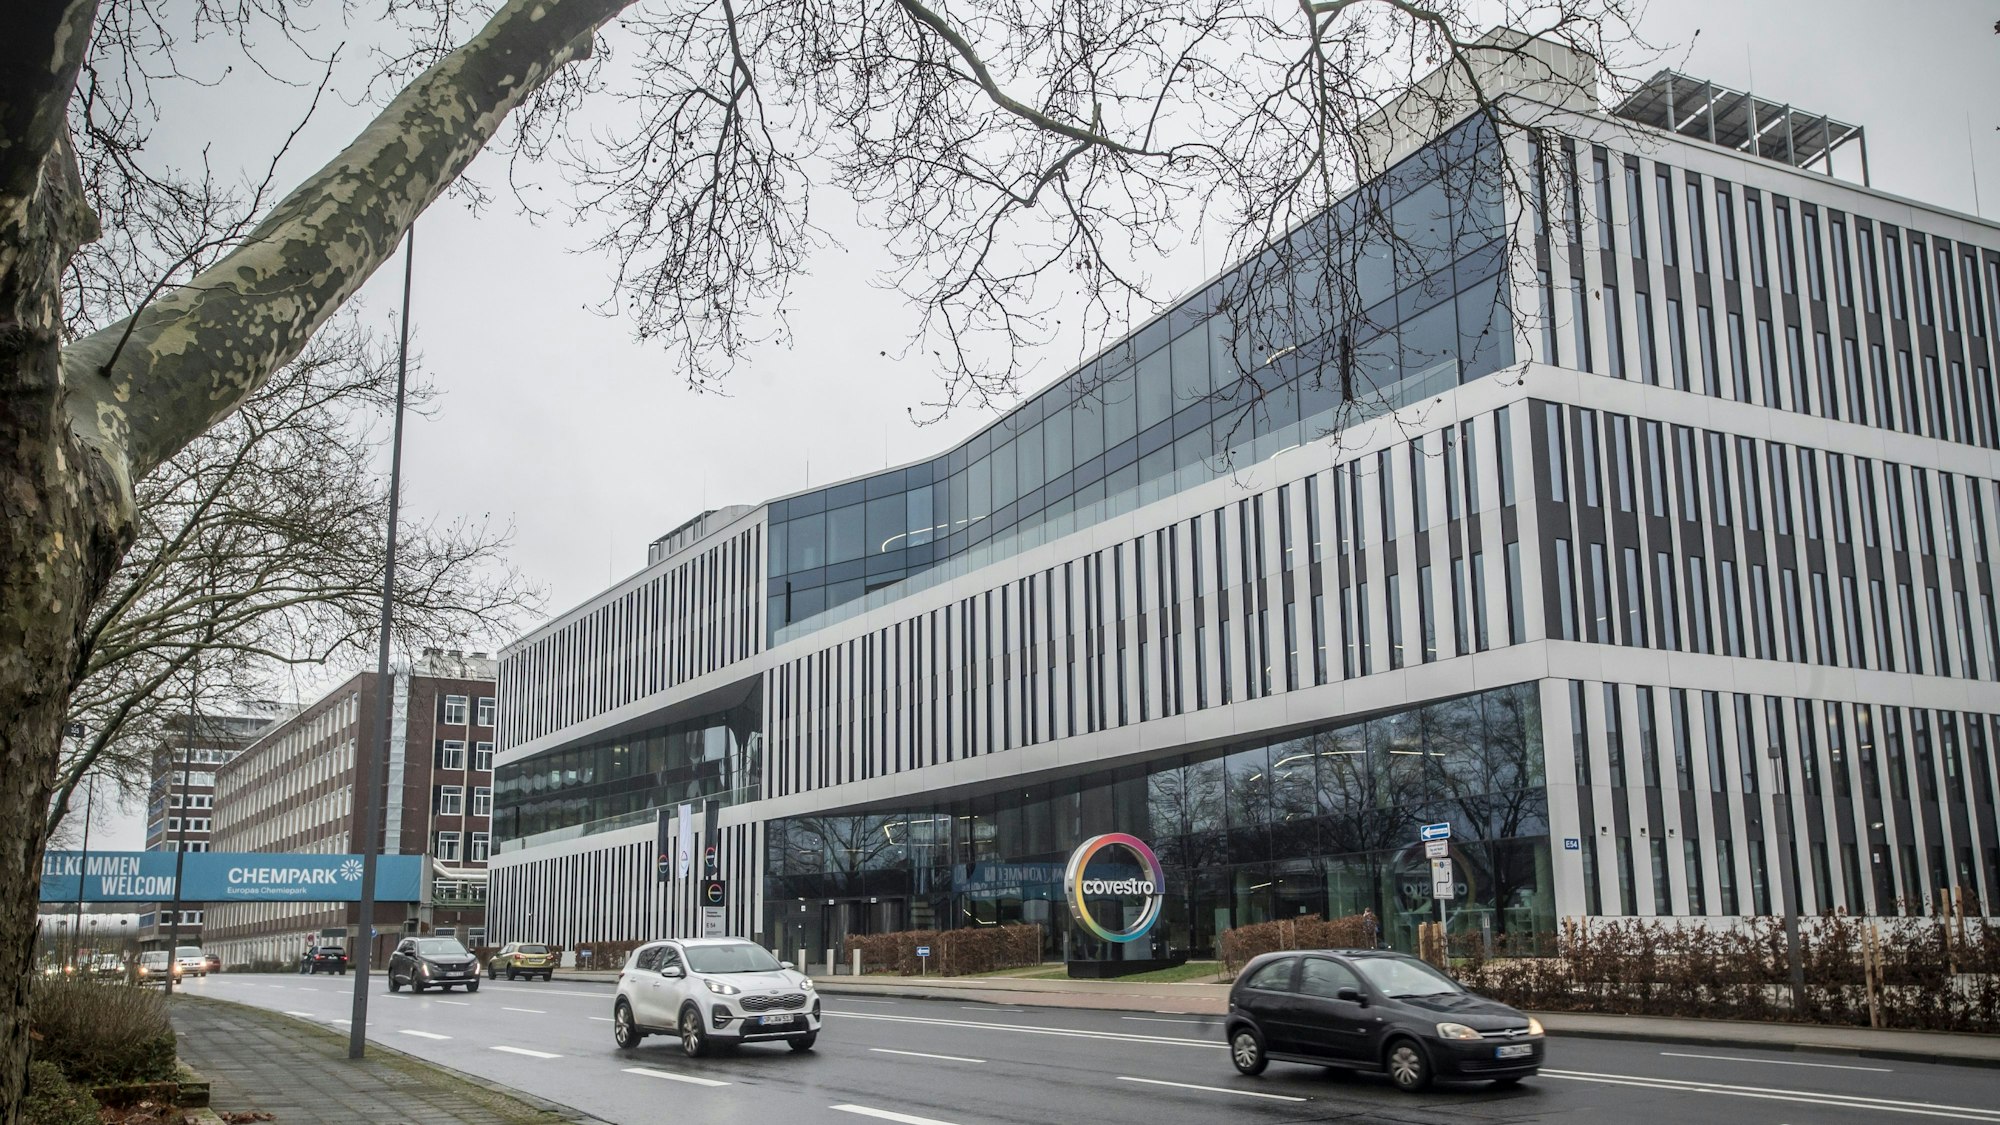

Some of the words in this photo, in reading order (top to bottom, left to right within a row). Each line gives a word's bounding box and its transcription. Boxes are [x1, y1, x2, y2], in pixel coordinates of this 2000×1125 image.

[1566, 840, 1578, 848] E54
[42, 856, 140, 876] ILLKOMMEN
[228, 867, 338, 884] CHEMPARK
[261, 886, 307, 895] Chemiepark
[1082, 877, 1154, 895] covestro
